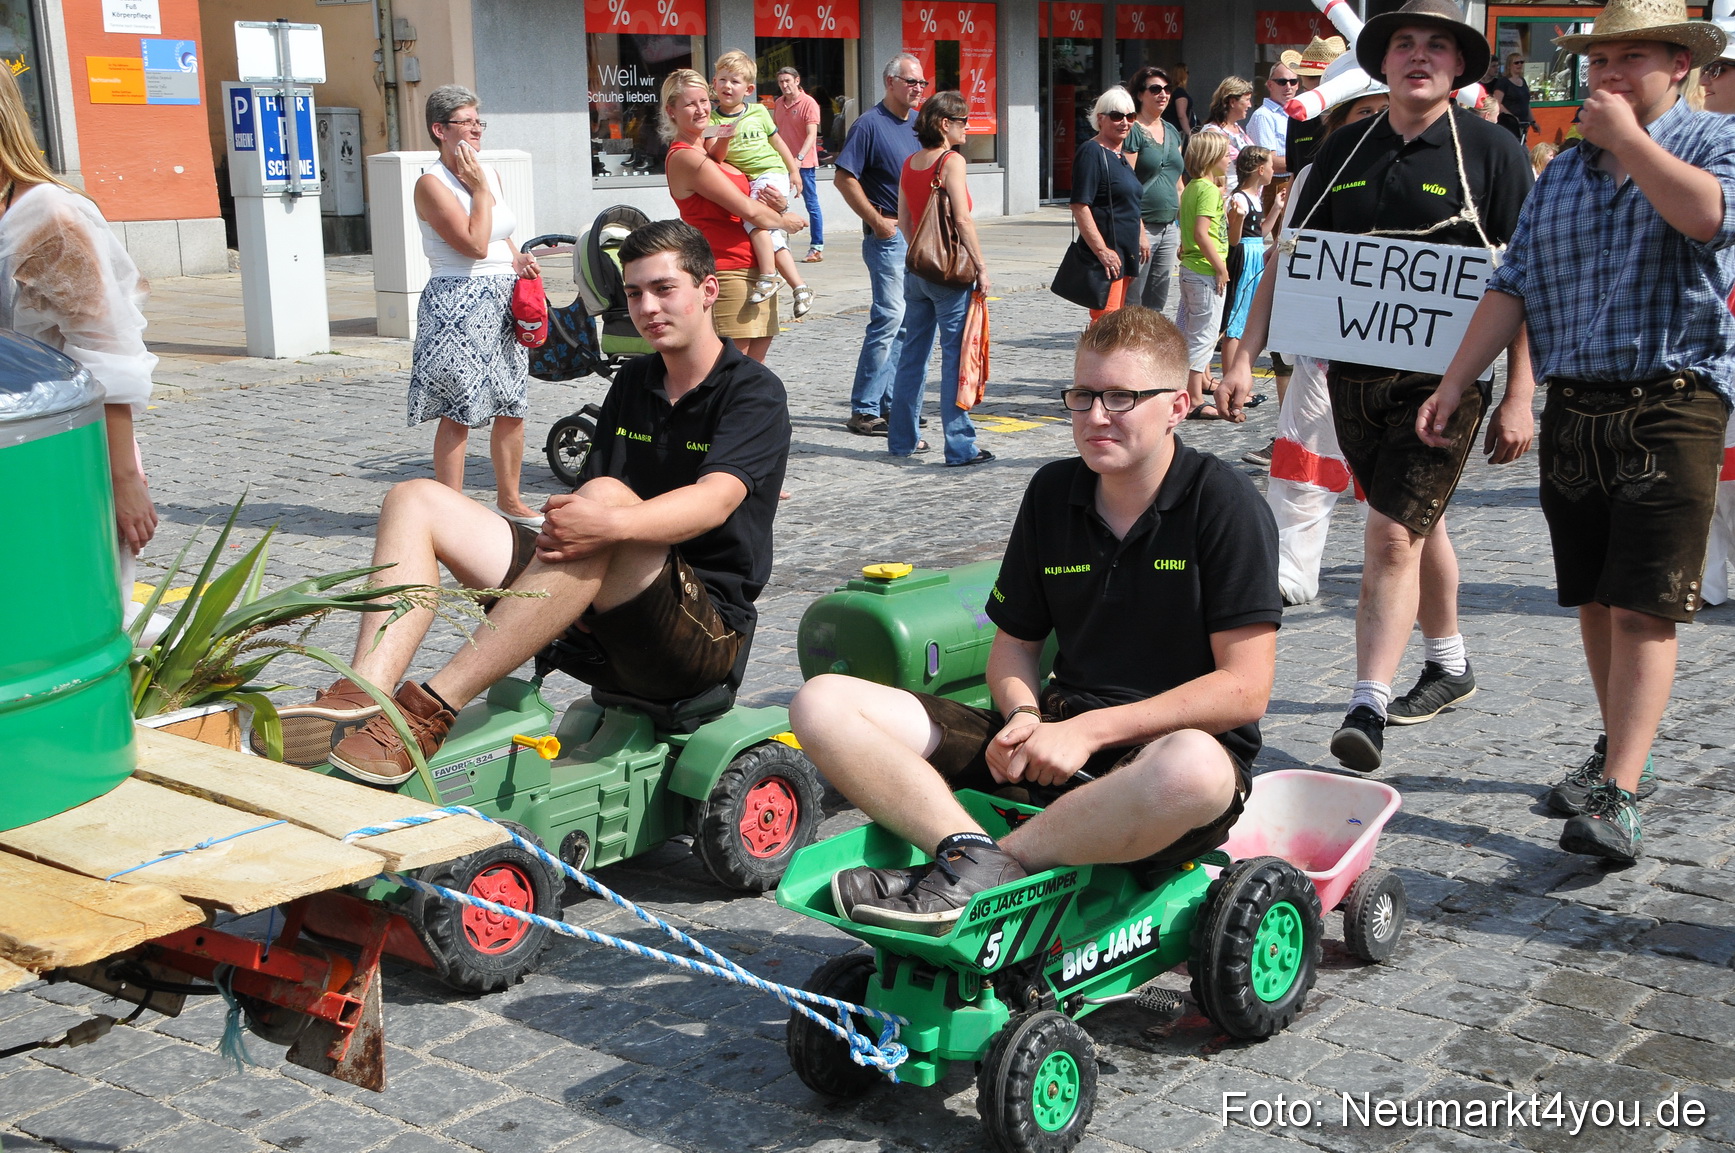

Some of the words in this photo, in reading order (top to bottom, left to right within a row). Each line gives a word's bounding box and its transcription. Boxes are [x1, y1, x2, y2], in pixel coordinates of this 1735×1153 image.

[111, 11, 152, 20] Körperpflege
[597, 64, 637, 87] Weil
[639, 74, 656, 87] wir
[265, 96, 305, 112] HIR
[587, 90, 625, 104] Schuhe
[626, 90, 659, 104] lieben.
[970, 95, 987, 104] Preis
[234, 96, 248, 125] P
[1337, 296, 1454, 348] WIRT
[1045, 566, 1062, 576] KLJB
[1062, 563, 1091, 573] LAABER
[1153, 558, 1187, 571] CHRIS
[476, 753, 494, 764] 824
[969, 901, 991, 923] BIG
[993, 890, 1026, 914] JAKE
[1027, 871, 1078, 903] DUMPER
[983, 931, 1003, 968] 5
[1062, 941, 1099, 982] BIG
[1103, 915, 1153, 963] JAKE
